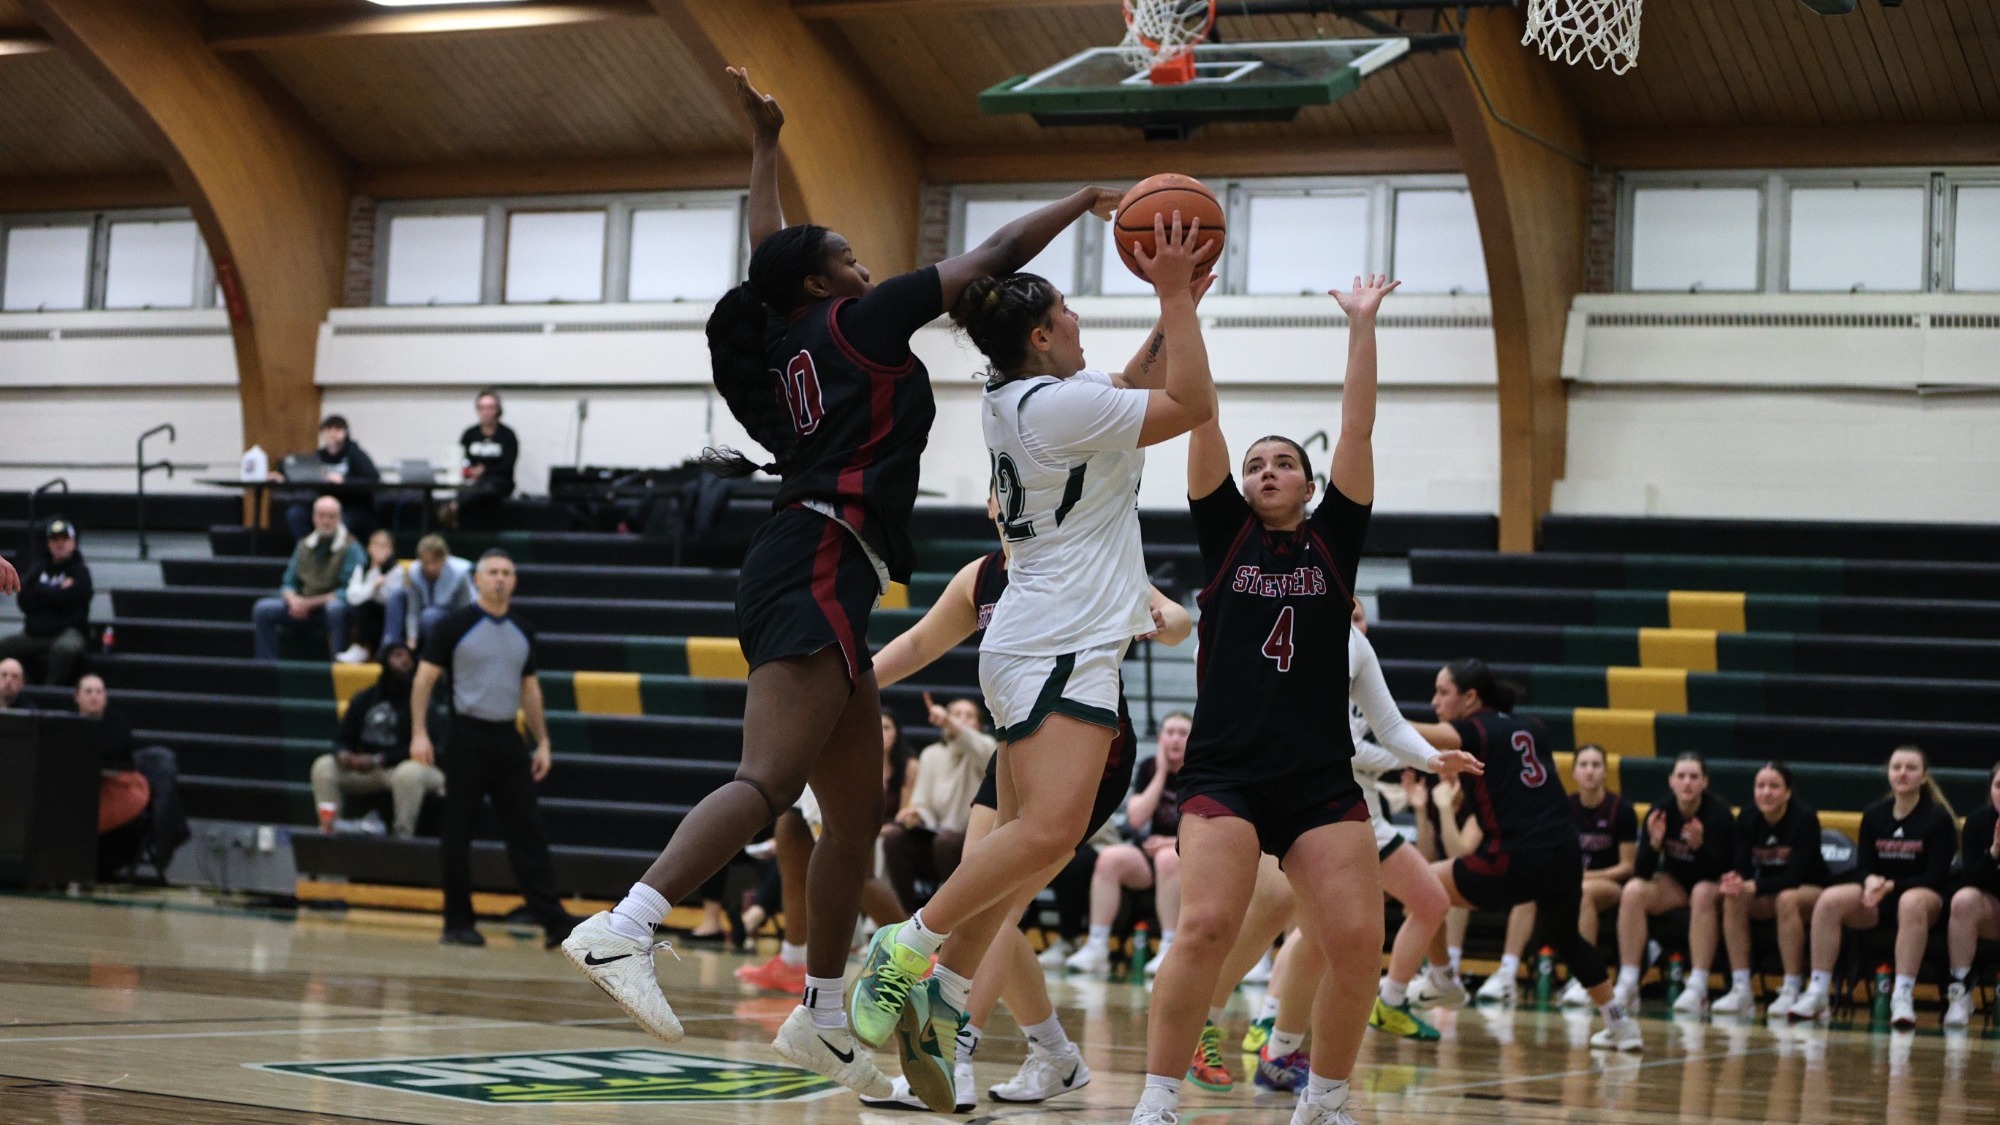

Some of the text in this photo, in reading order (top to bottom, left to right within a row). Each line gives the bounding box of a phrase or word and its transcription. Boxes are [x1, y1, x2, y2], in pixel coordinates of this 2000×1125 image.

[1232, 565, 1327, 597] STEVENS
[1261, 605, 1294, 672] 4
[1511, 730, 1547, 788] 3
